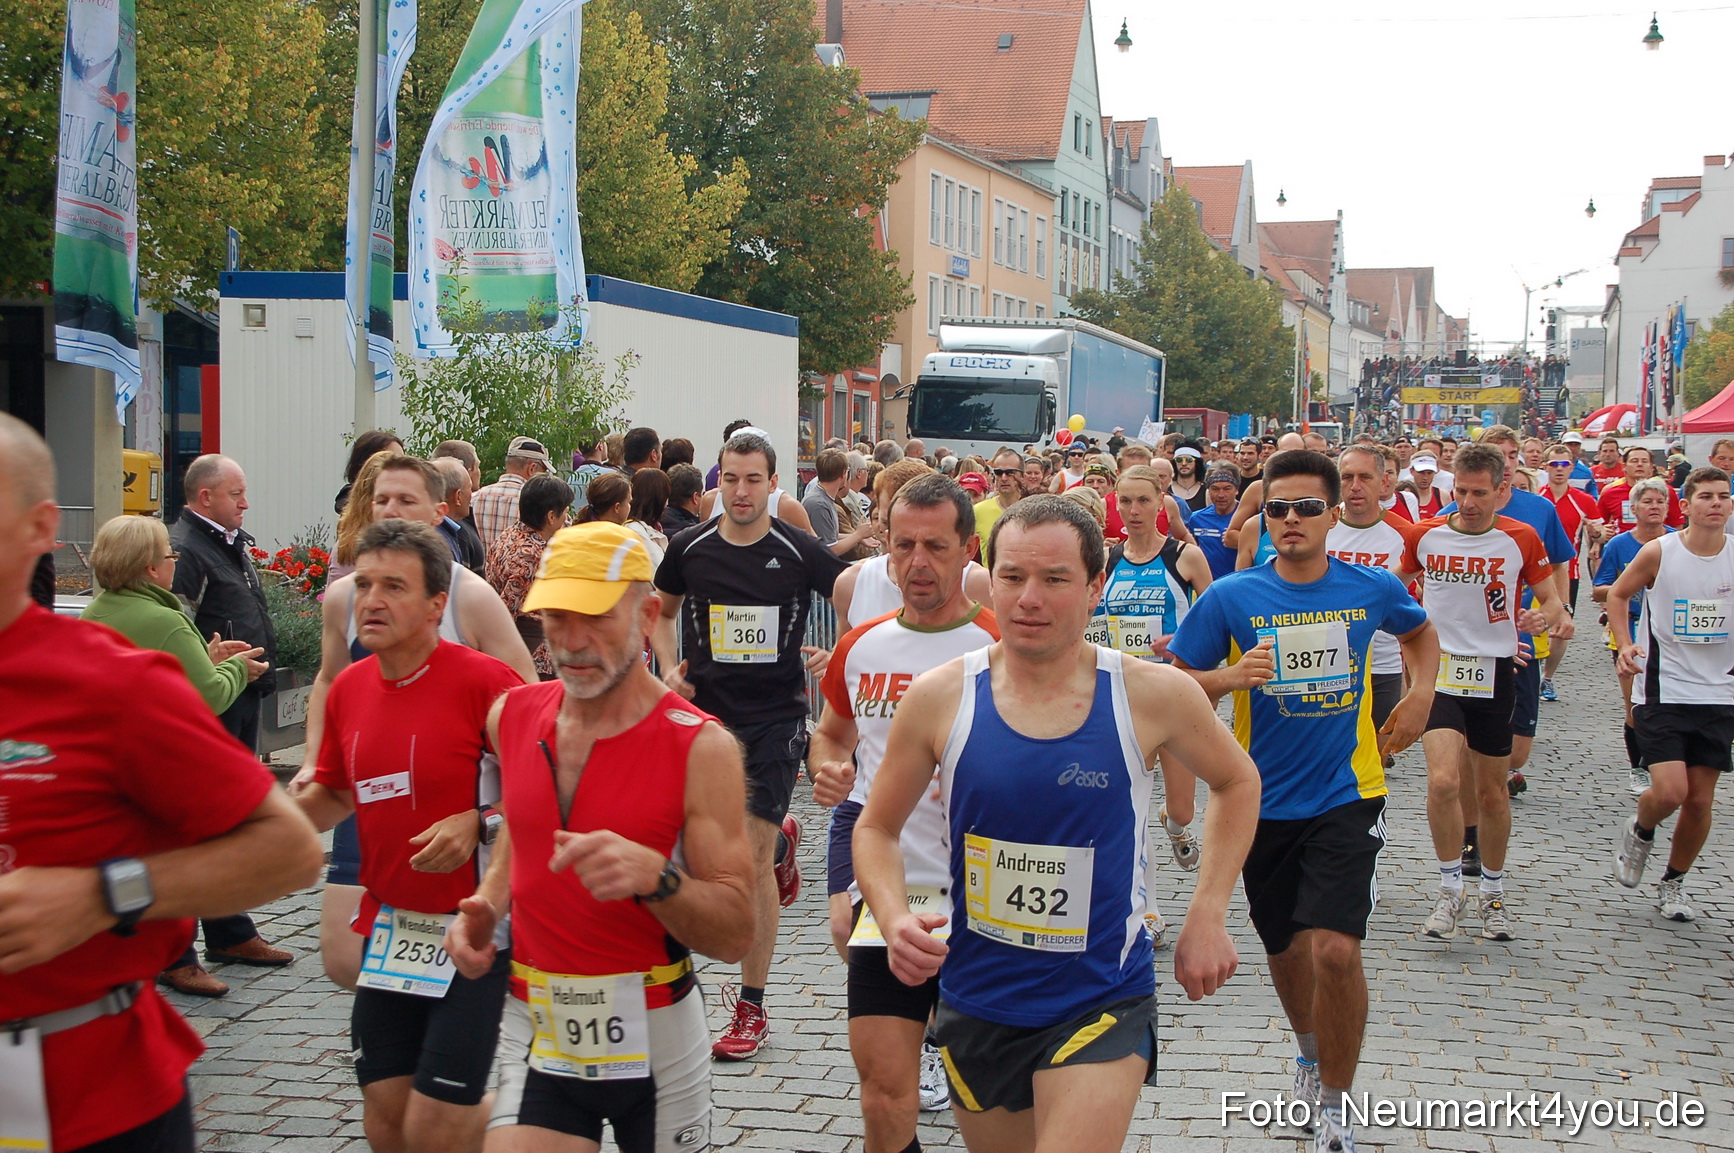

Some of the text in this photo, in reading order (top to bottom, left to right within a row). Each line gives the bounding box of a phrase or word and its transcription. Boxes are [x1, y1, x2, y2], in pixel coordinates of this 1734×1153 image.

[950, 356, 1012, 370] BOCK
[1439, 390, 1480, 401] START
[1426, 555, 1505, 575] MERZ
[1425, 565, 1487, 584] Reisen
[1116, 589, 1167, 600] NAGEL
[1128, 605, 1140, 613] 08
[1142, 605, 1165, 614] Roth
[1690, 603, 1717, 612] Patrick
[726, 610, 756, 622] Martin
[1250, 616, 1269, 628] 10.
[1272, 608, 1367, 627] NEUMARKTER
[1691, 616, 1726, 628] 3577
[1119, 619, 1146, 629] Simone
[733, 628, 767, 644] 360
[1125, 633, 1152, 647] 664
[1286, 648, 1338, 670] 3877
[1455, 667, 1485, 682] 516
[858, 672, 908, 701] ME
[1317, 678, 1350, 688] PFLEIDERER
[370, 781, 396, 795] DEHN
[996, 849, 1066, 876] Andreas
[970, 872, 977, 886] B
[1005, 884, 1069, 917] 432
[396, 914, 446, 937] Wendelin
[1036, 932, 1085, 945] PFLEIDERER
[394, 938, 450, 968] 2530
[551, 985, 606, 1006] Helmut
[566, 1015, 625, 1045] 916
